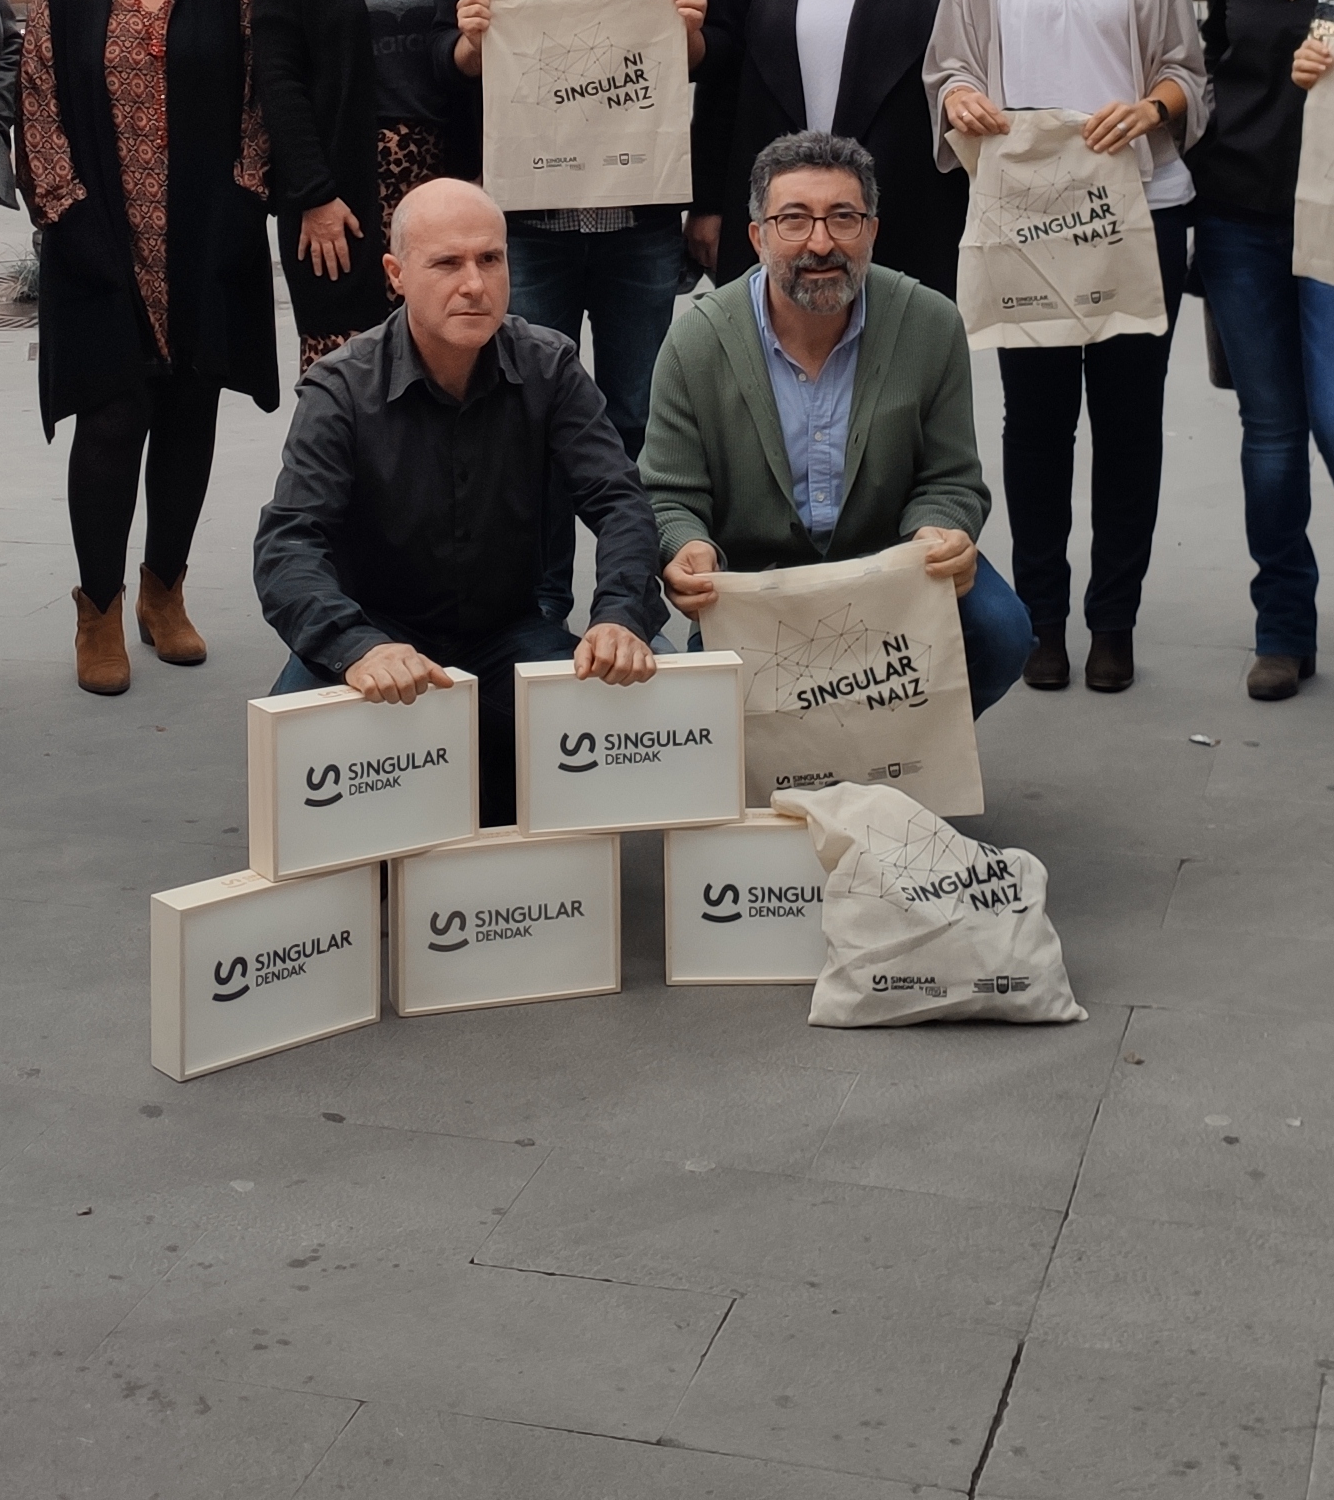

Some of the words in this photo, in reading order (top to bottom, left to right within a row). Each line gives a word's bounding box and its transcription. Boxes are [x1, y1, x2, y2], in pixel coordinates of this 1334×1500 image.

[624, 52, 643, 69] NI
[554, 68, 649, 104] SINGULAR
[607, 86, 652, 109] NAIZ
[1087, 185, 1108, 203] NI
[1016, 203, 1116, 244] SINGULAR
[1073, 220, 1121, 246] NAIZ
[882, 633, 909, 656] NI
[797, 655, 918, 710] SINGULAR
[866, 677, 925, 710] NAIZ
[604, 728, 713, 751] SINGULAR
[348, 747, 449, 781] SINGULAR
[605, 750, 661, 765] DENDAK
[349, 775, 401, 796] DENDAK
[793, 772, 834, 781] SINGULAR
[901, 859, 1015, 902] SINGULAR
[969, 883, 1022, 911] NAIZ
[474, 900, 585, 928] SINGULAR
[748, 905, 806, 918] DENDAK
[475, 925, 533, 943] DENDAK
[255, 929, 353, 972] SINGULAR
[255, 961, 307, 987] DENDAK
[891, 976, 936, 985] SINGULAR
